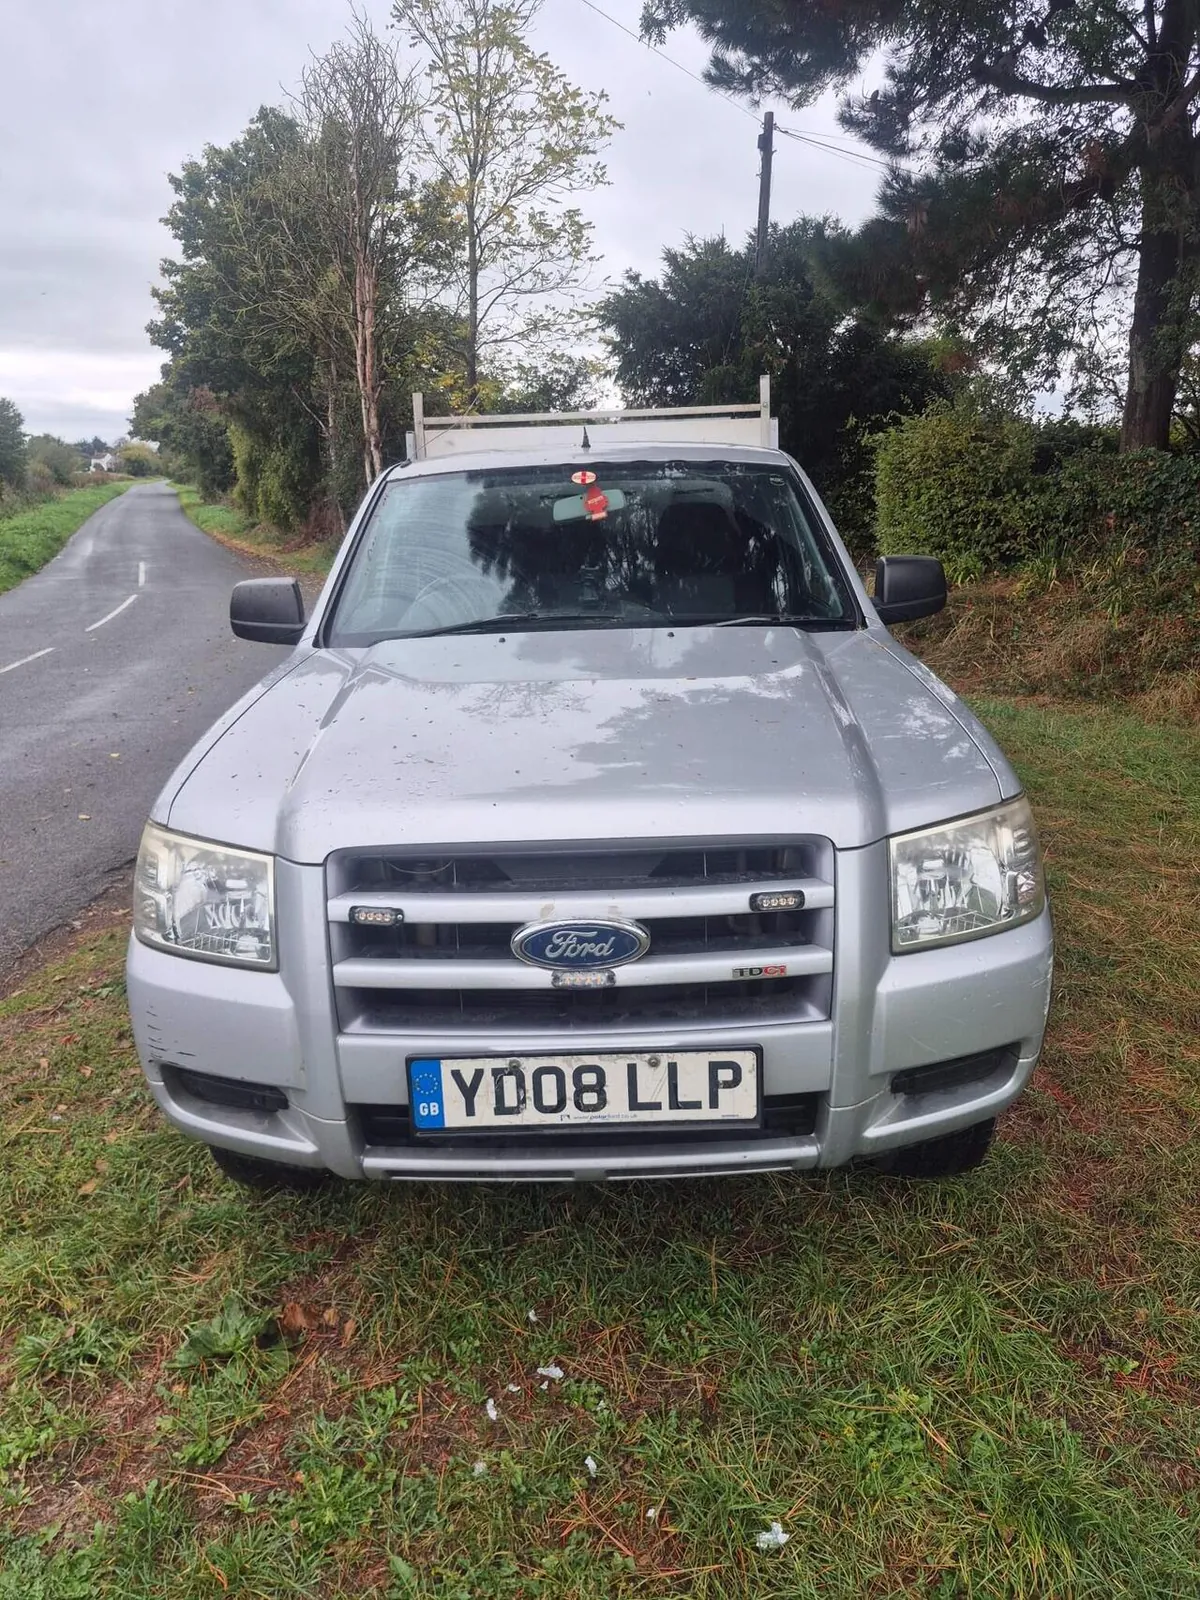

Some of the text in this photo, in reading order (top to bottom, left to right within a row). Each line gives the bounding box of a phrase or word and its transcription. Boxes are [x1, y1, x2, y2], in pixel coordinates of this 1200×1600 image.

[545, 930, 616, 958] Ford
[451, 1060, 743, 1117] YD08 LLP
[419, 1102, 440, 1117] GB
